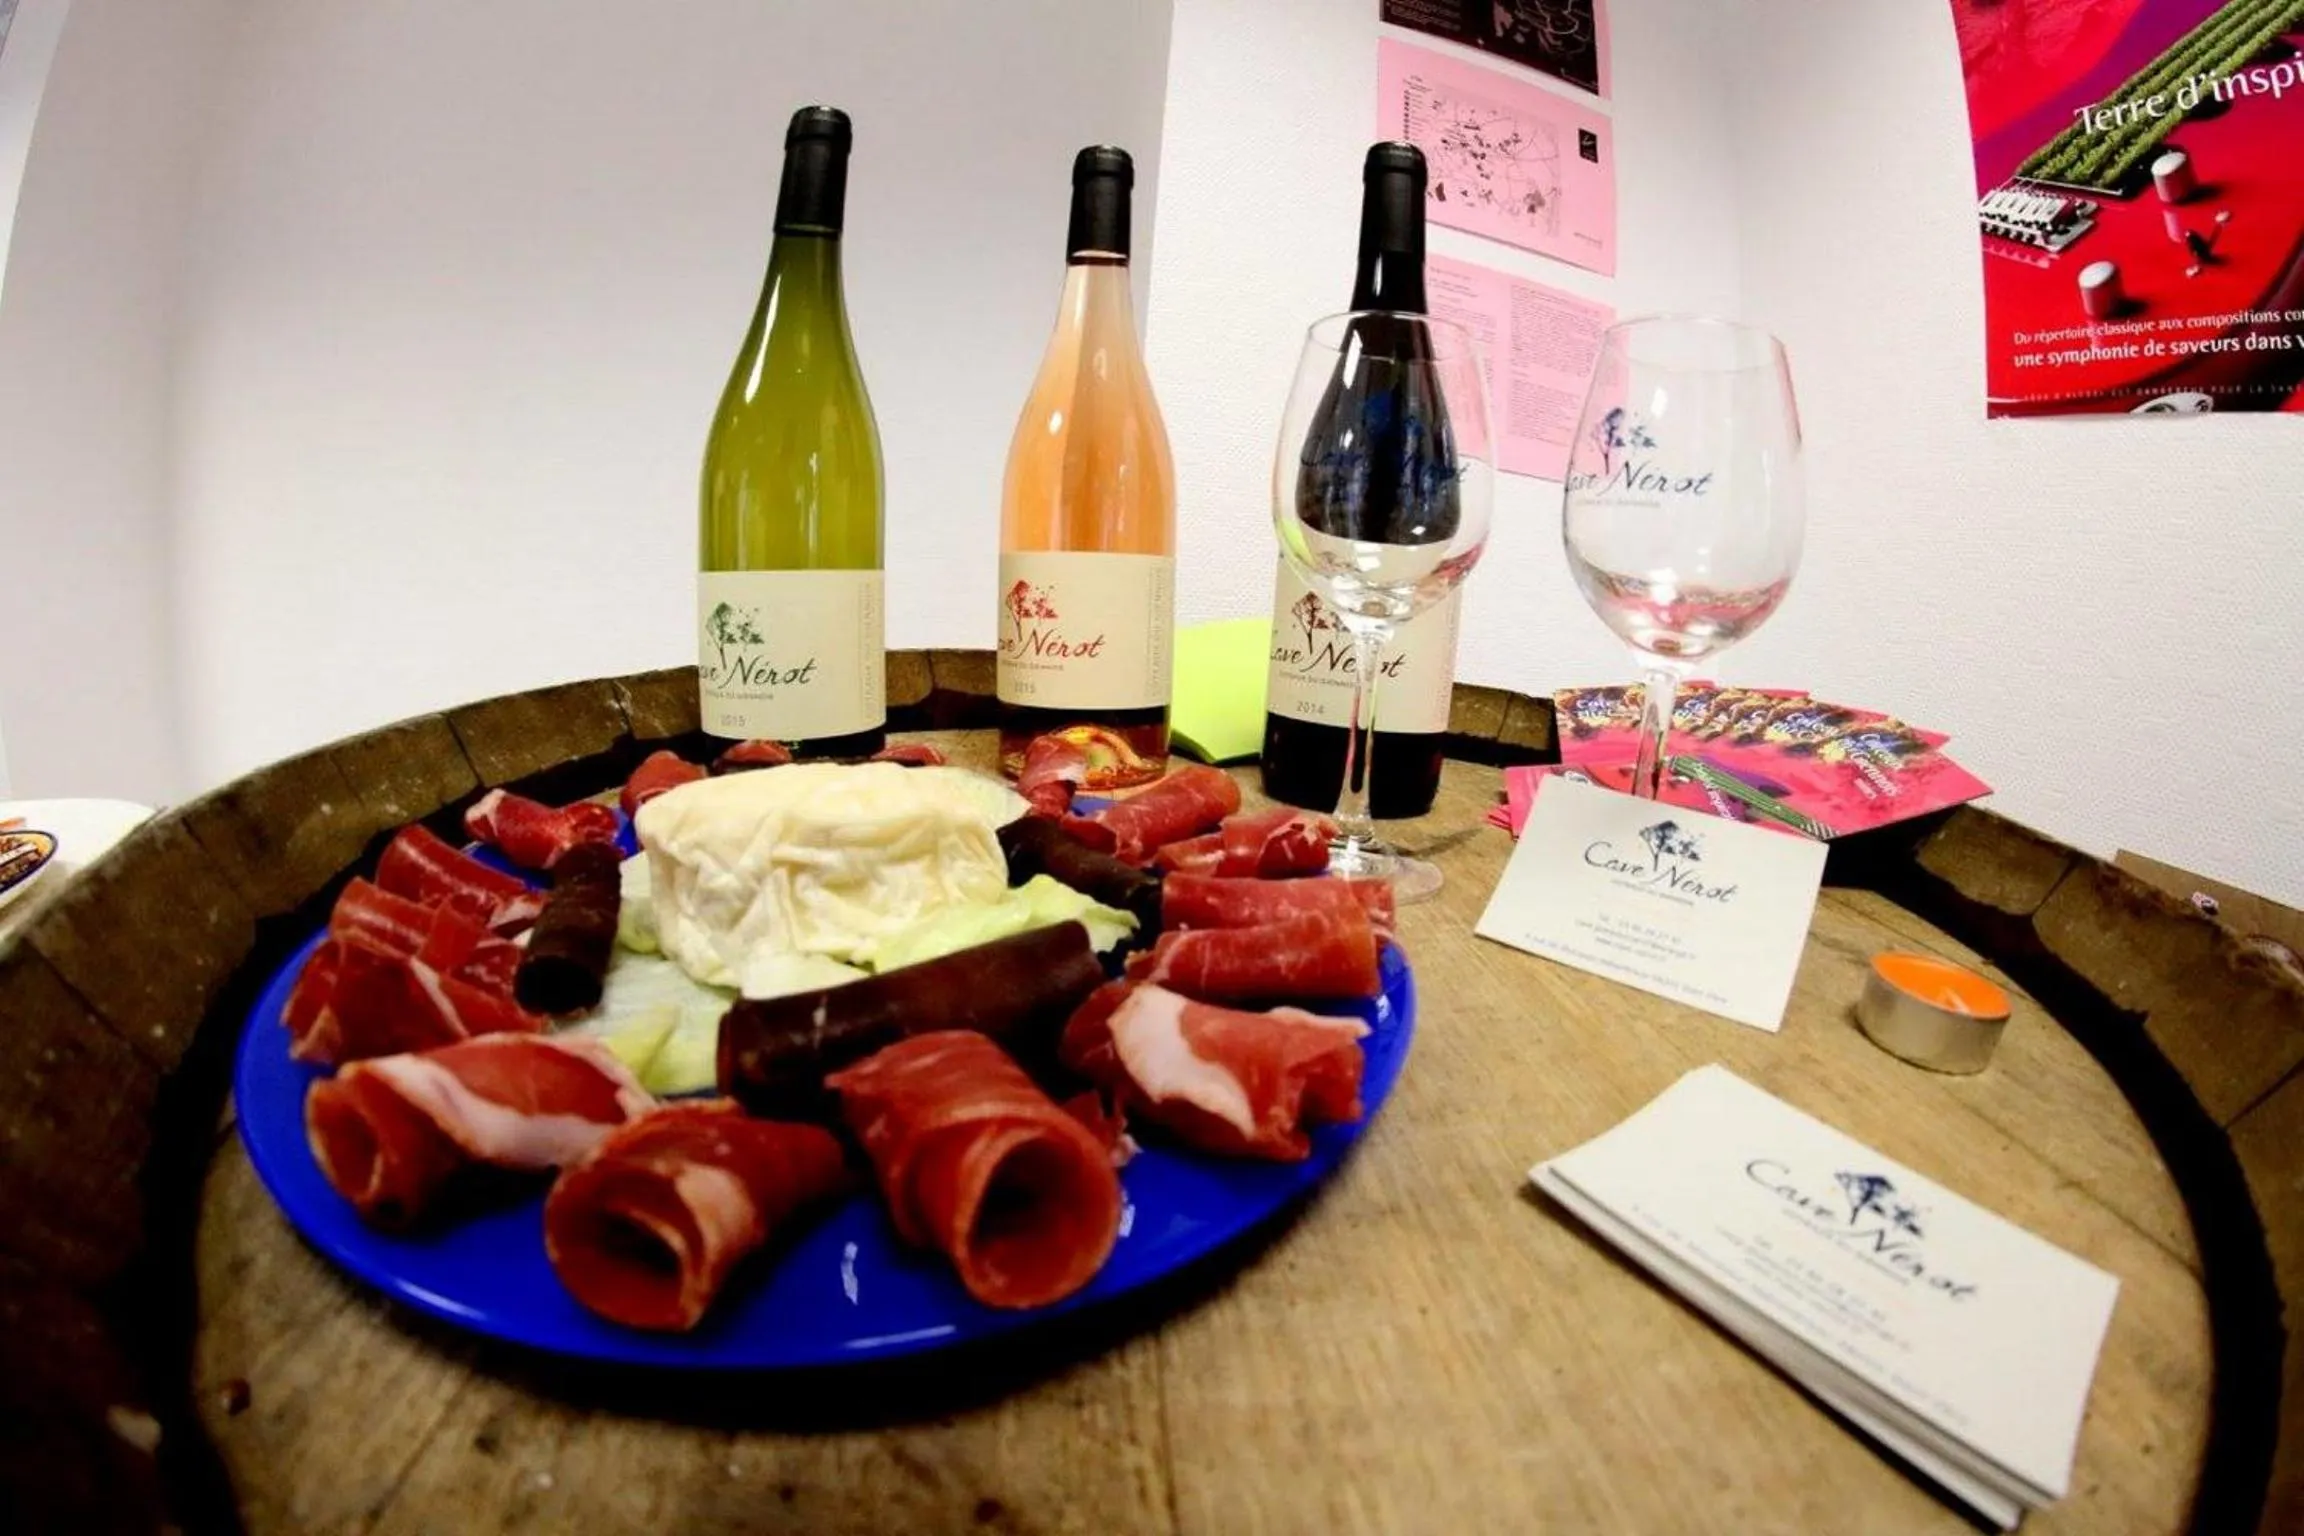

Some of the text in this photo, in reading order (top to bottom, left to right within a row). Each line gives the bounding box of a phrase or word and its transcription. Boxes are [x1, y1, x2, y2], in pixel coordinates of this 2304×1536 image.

[2073, 93, 2167, 134] Terre
[2014, 332, 2031, 344] Du
[2034, 326, 2093, 344] répertoire
[2096, 320, 2155, 336] classique
[2158, 319, 2183, 330] aux
[2187, 309, 2280, 328] compositions
[2014, 354, 2043, 367] une
[2047, 342, 2139, 367] symphonie
[2144, 338, 2165, 356] de
[2170, 337, 2240, 354] saveurs
[2245, 332, 2292, 350] dans
[1013, 628, 1106, 660] Nérot
[717, 655, 817, 690] Nérot
[1584, 841, 1644, 876] Cave
[1746, 1159, 1836, 1219] Cave
